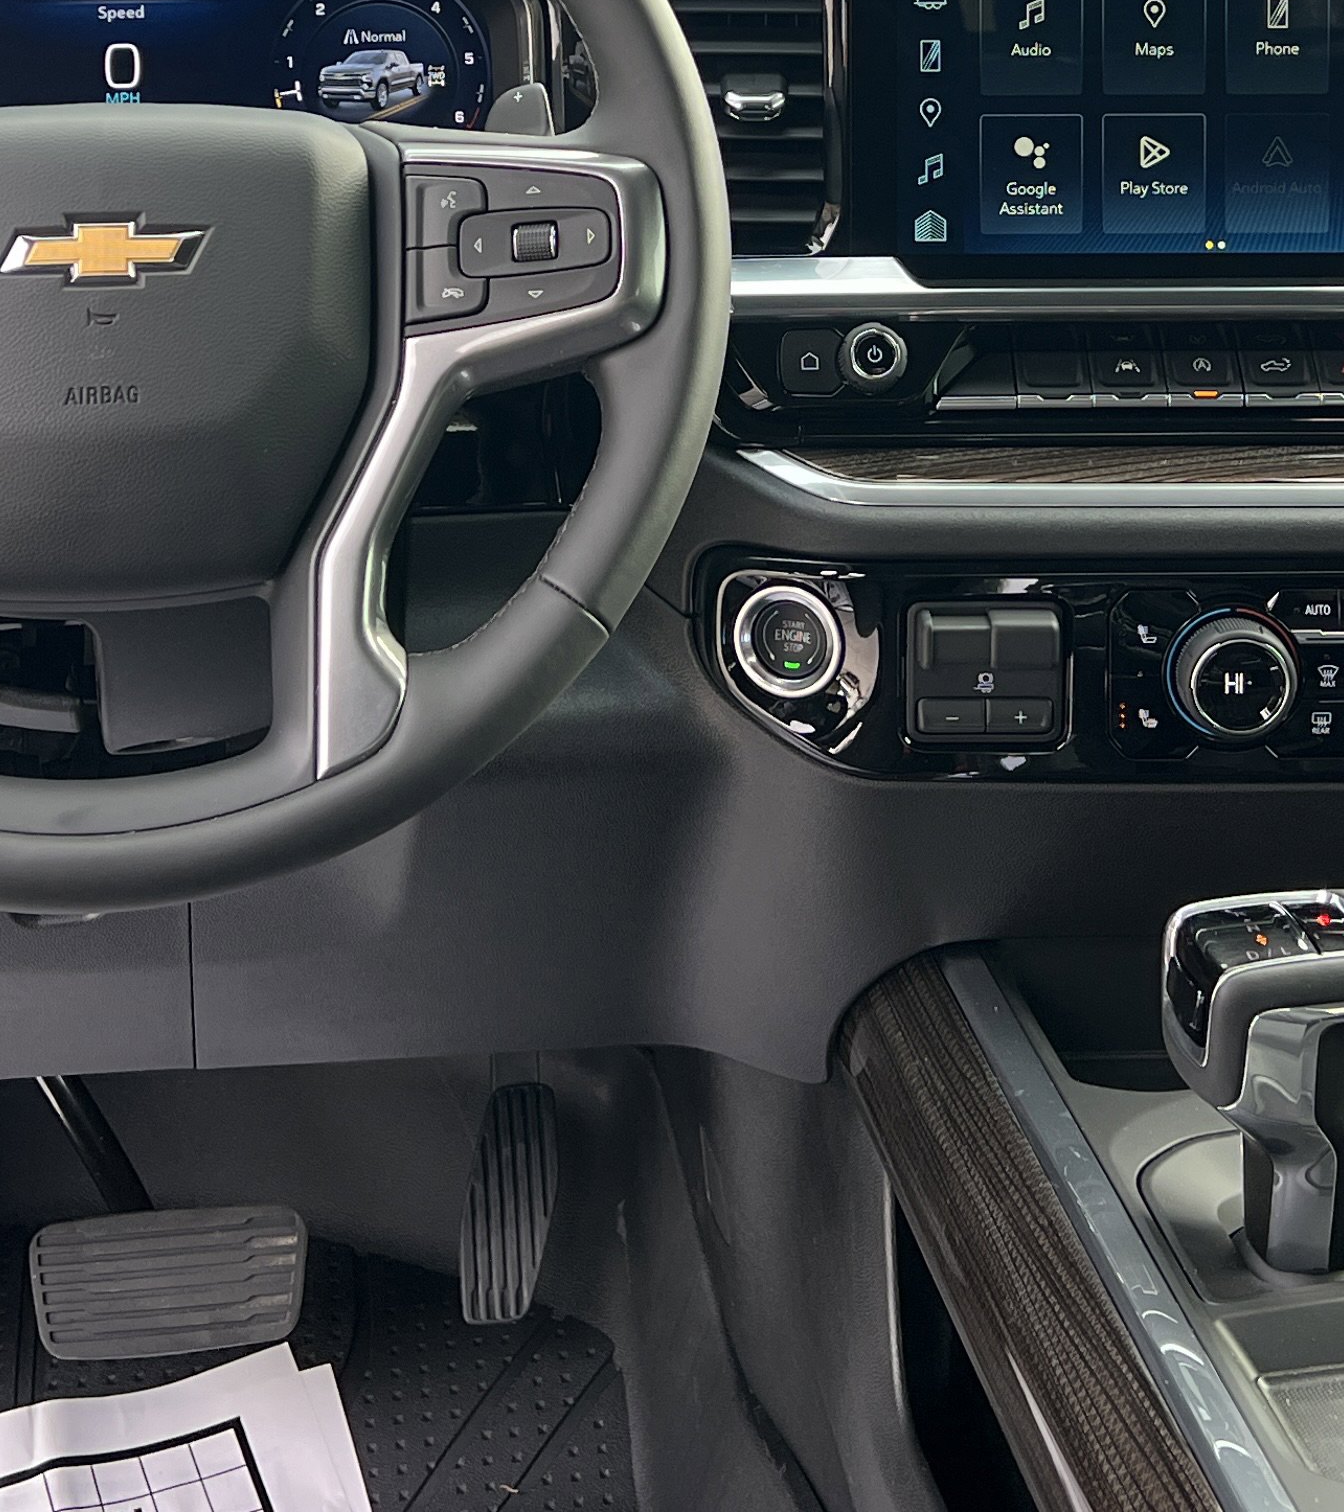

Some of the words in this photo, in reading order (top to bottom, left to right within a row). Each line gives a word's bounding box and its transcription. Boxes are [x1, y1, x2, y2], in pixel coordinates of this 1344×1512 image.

[98, 5, 145, 23] Speed
[315, 3, 325, 16] 2
[431, 1, 441, 14] 4
[360, 29, 406, 43] Normal
[1011, 42, 1051, 57] Audio
[1135, 42, 1174, 59] Maps
[1256, 42, 1299, 56] Phone
[286, 56, 293, 68] 1
[464, 52, 474, 65] 5
[105, 43, 141, 89] 0
[106, 92, 141, 104] MPH
[455, 111, 464, 124] 6
[1006, 182, 1056, 198] Google
[1120, 182, 1150, 197] Play
[1153, 182, 1188, 196] Store
[1232, 181, 1286, 194] Android
[1288, 181, 1323, 194] Auto
[999, 201, 1064, 216] Assistant
[64, 385, 139, 405] AIRBAG
[1305, 604, 1331, 616] AUTO
[782, 620, 806, 629] START
[774, 629, 812, 644] ENGINE
[783, 642, 804, 652] STOP
[1224, 672, 1244, 694] HI
[1319, 677, 1336, 687] MAX
